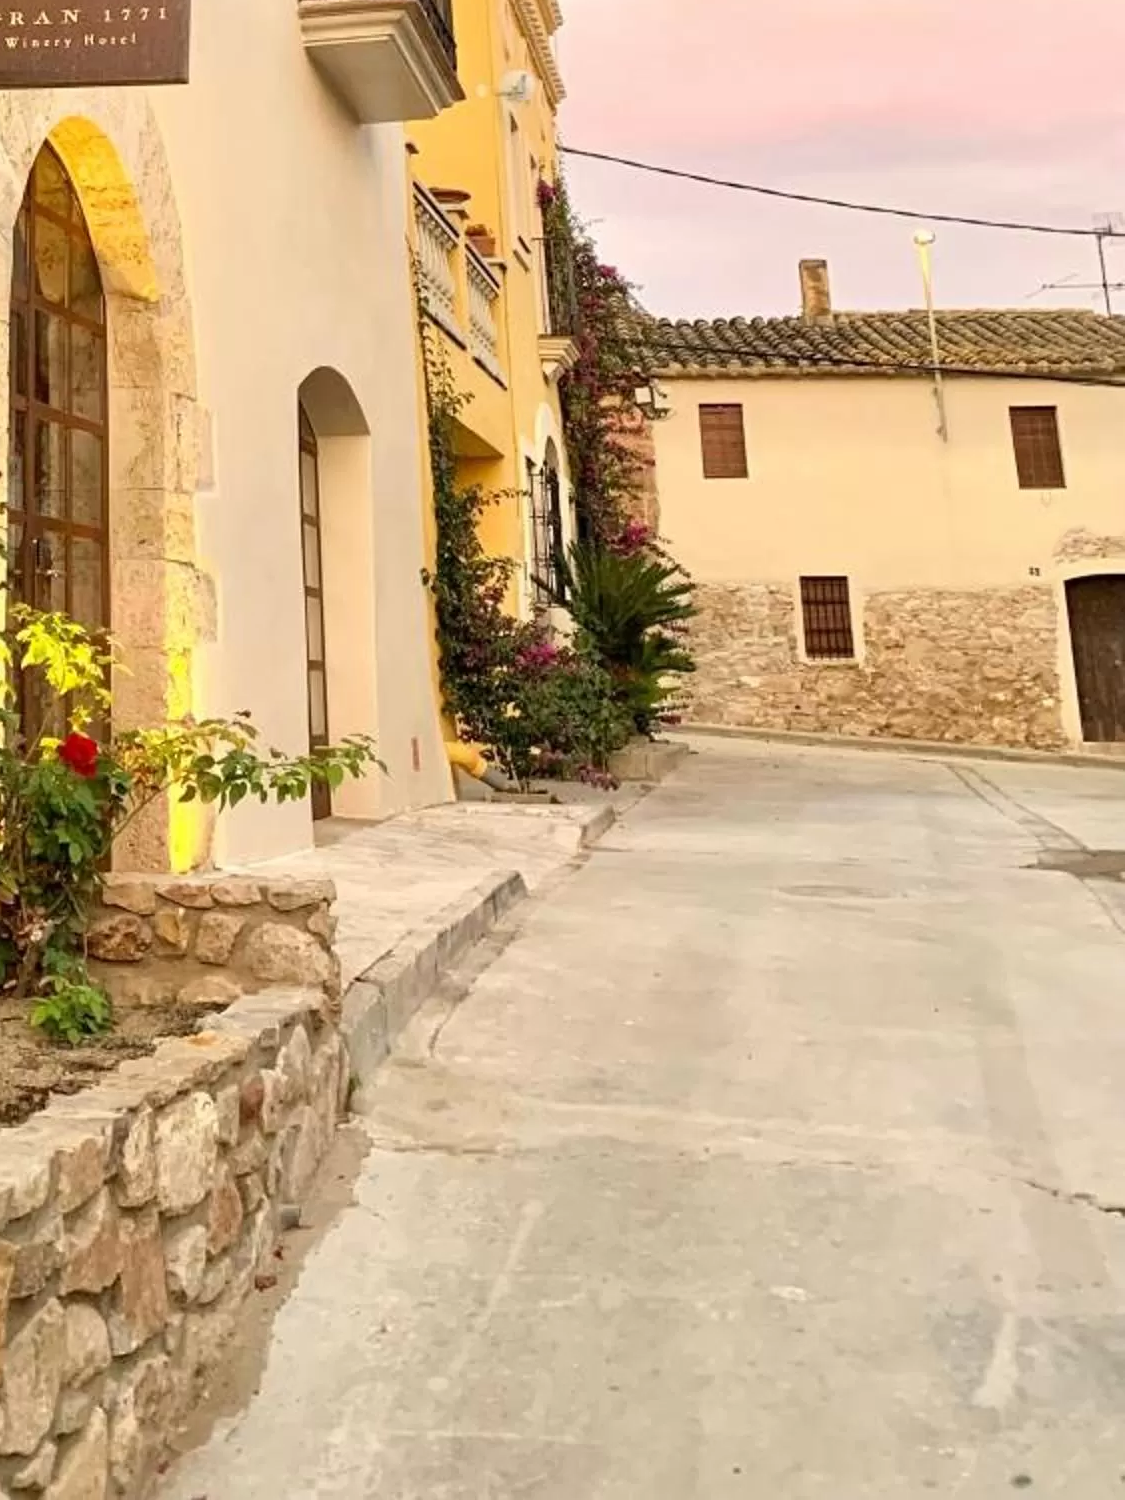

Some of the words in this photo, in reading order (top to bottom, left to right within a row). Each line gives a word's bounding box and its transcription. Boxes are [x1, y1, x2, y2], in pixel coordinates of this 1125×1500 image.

[104, 6, 167, 23] 1771
[4, 35, 72, 49] Winery
[83, 32, 137, 46] Hotel
